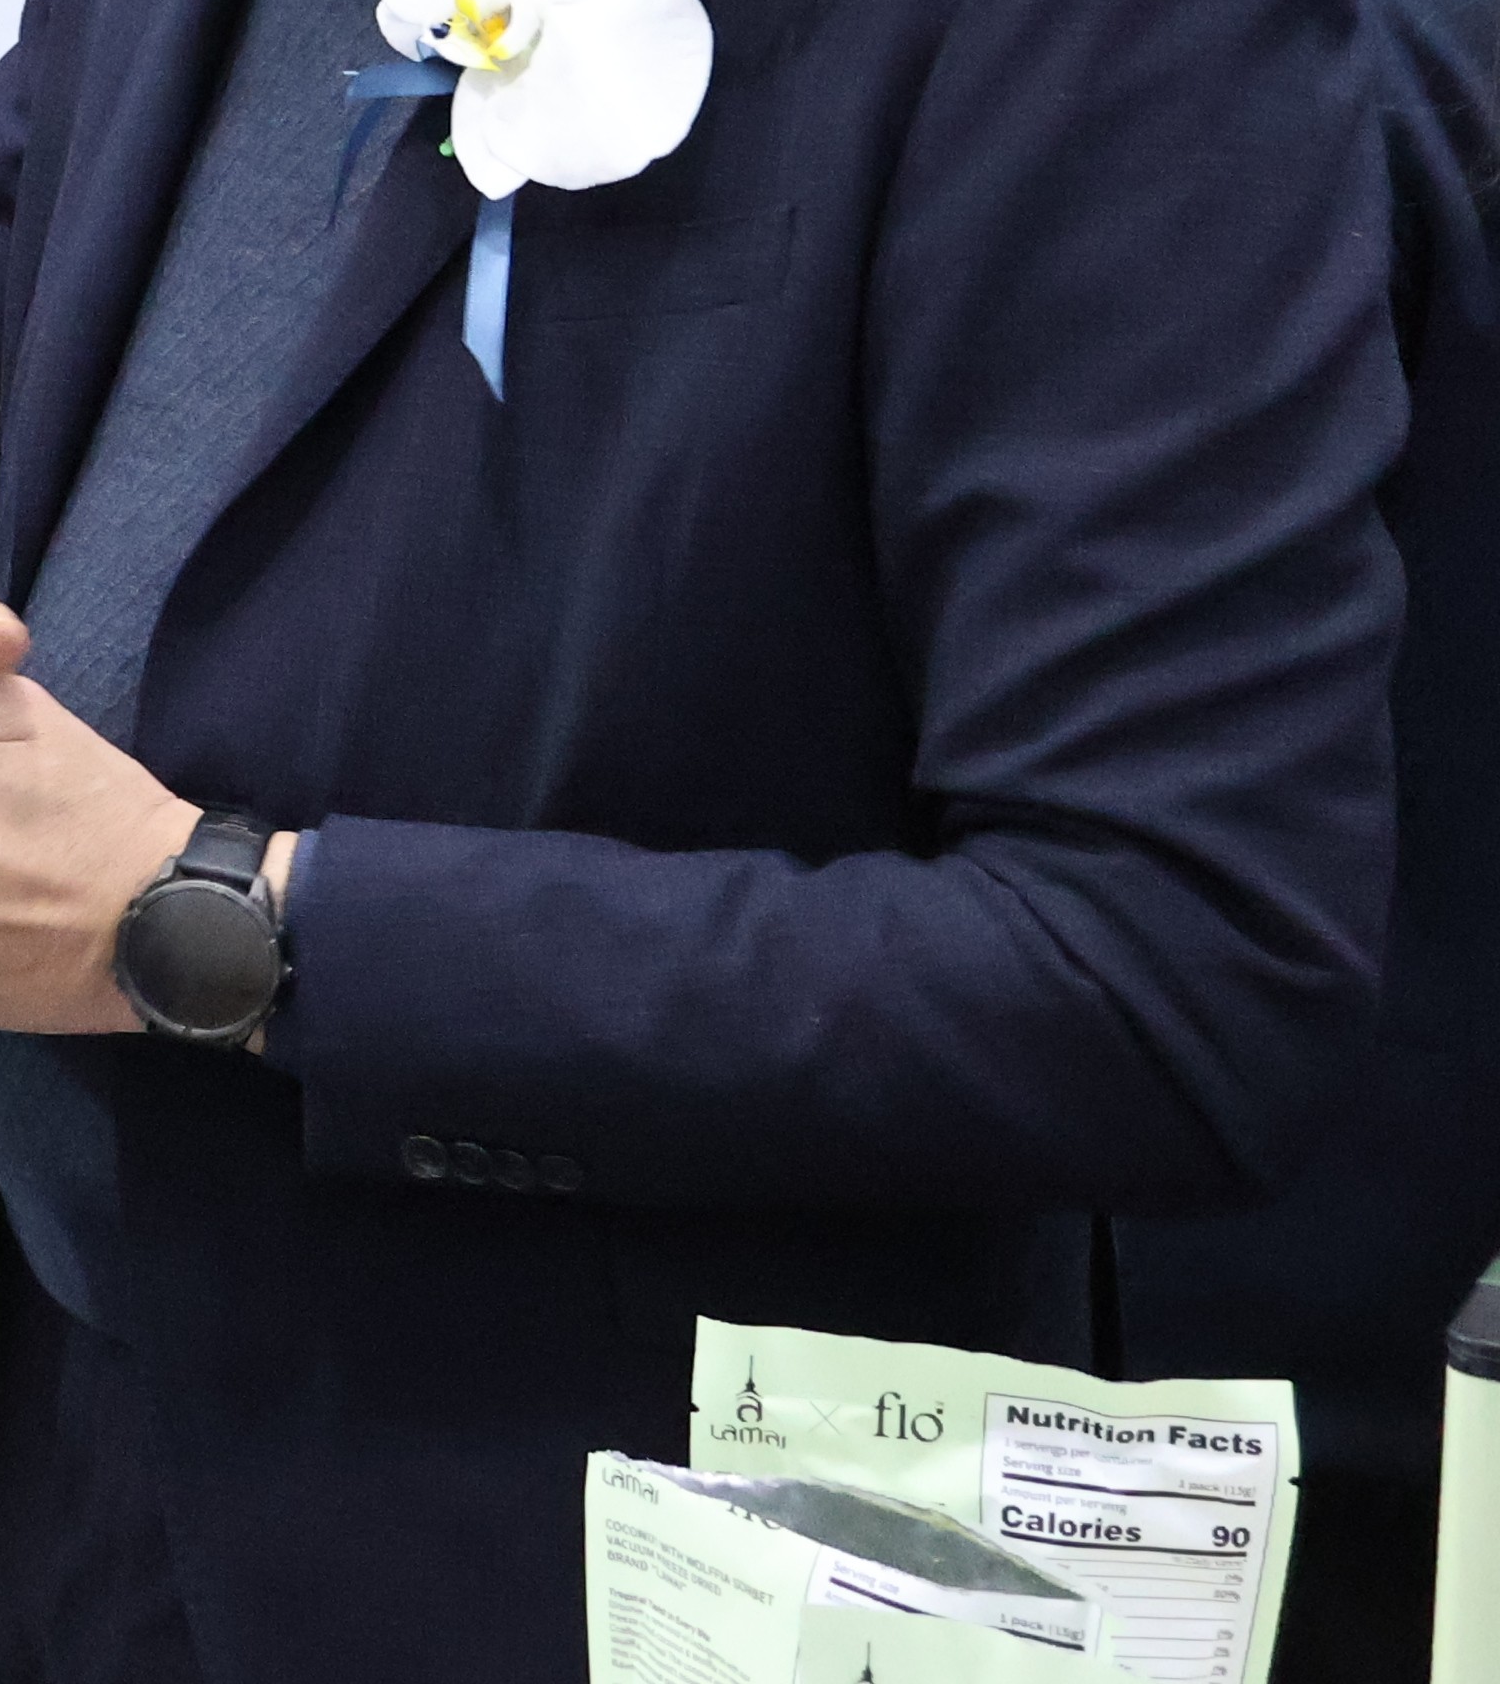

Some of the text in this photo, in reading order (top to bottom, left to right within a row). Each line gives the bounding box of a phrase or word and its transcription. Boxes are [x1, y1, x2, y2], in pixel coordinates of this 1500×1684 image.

[1006, 1405, 1263, 1457] Nutrition Facts
[1002, 1456, 1054, 1476] Serving
[1000, 1505, 1251, 1549] Calories 90
[1011, 1616, 1045, 1632] pack
